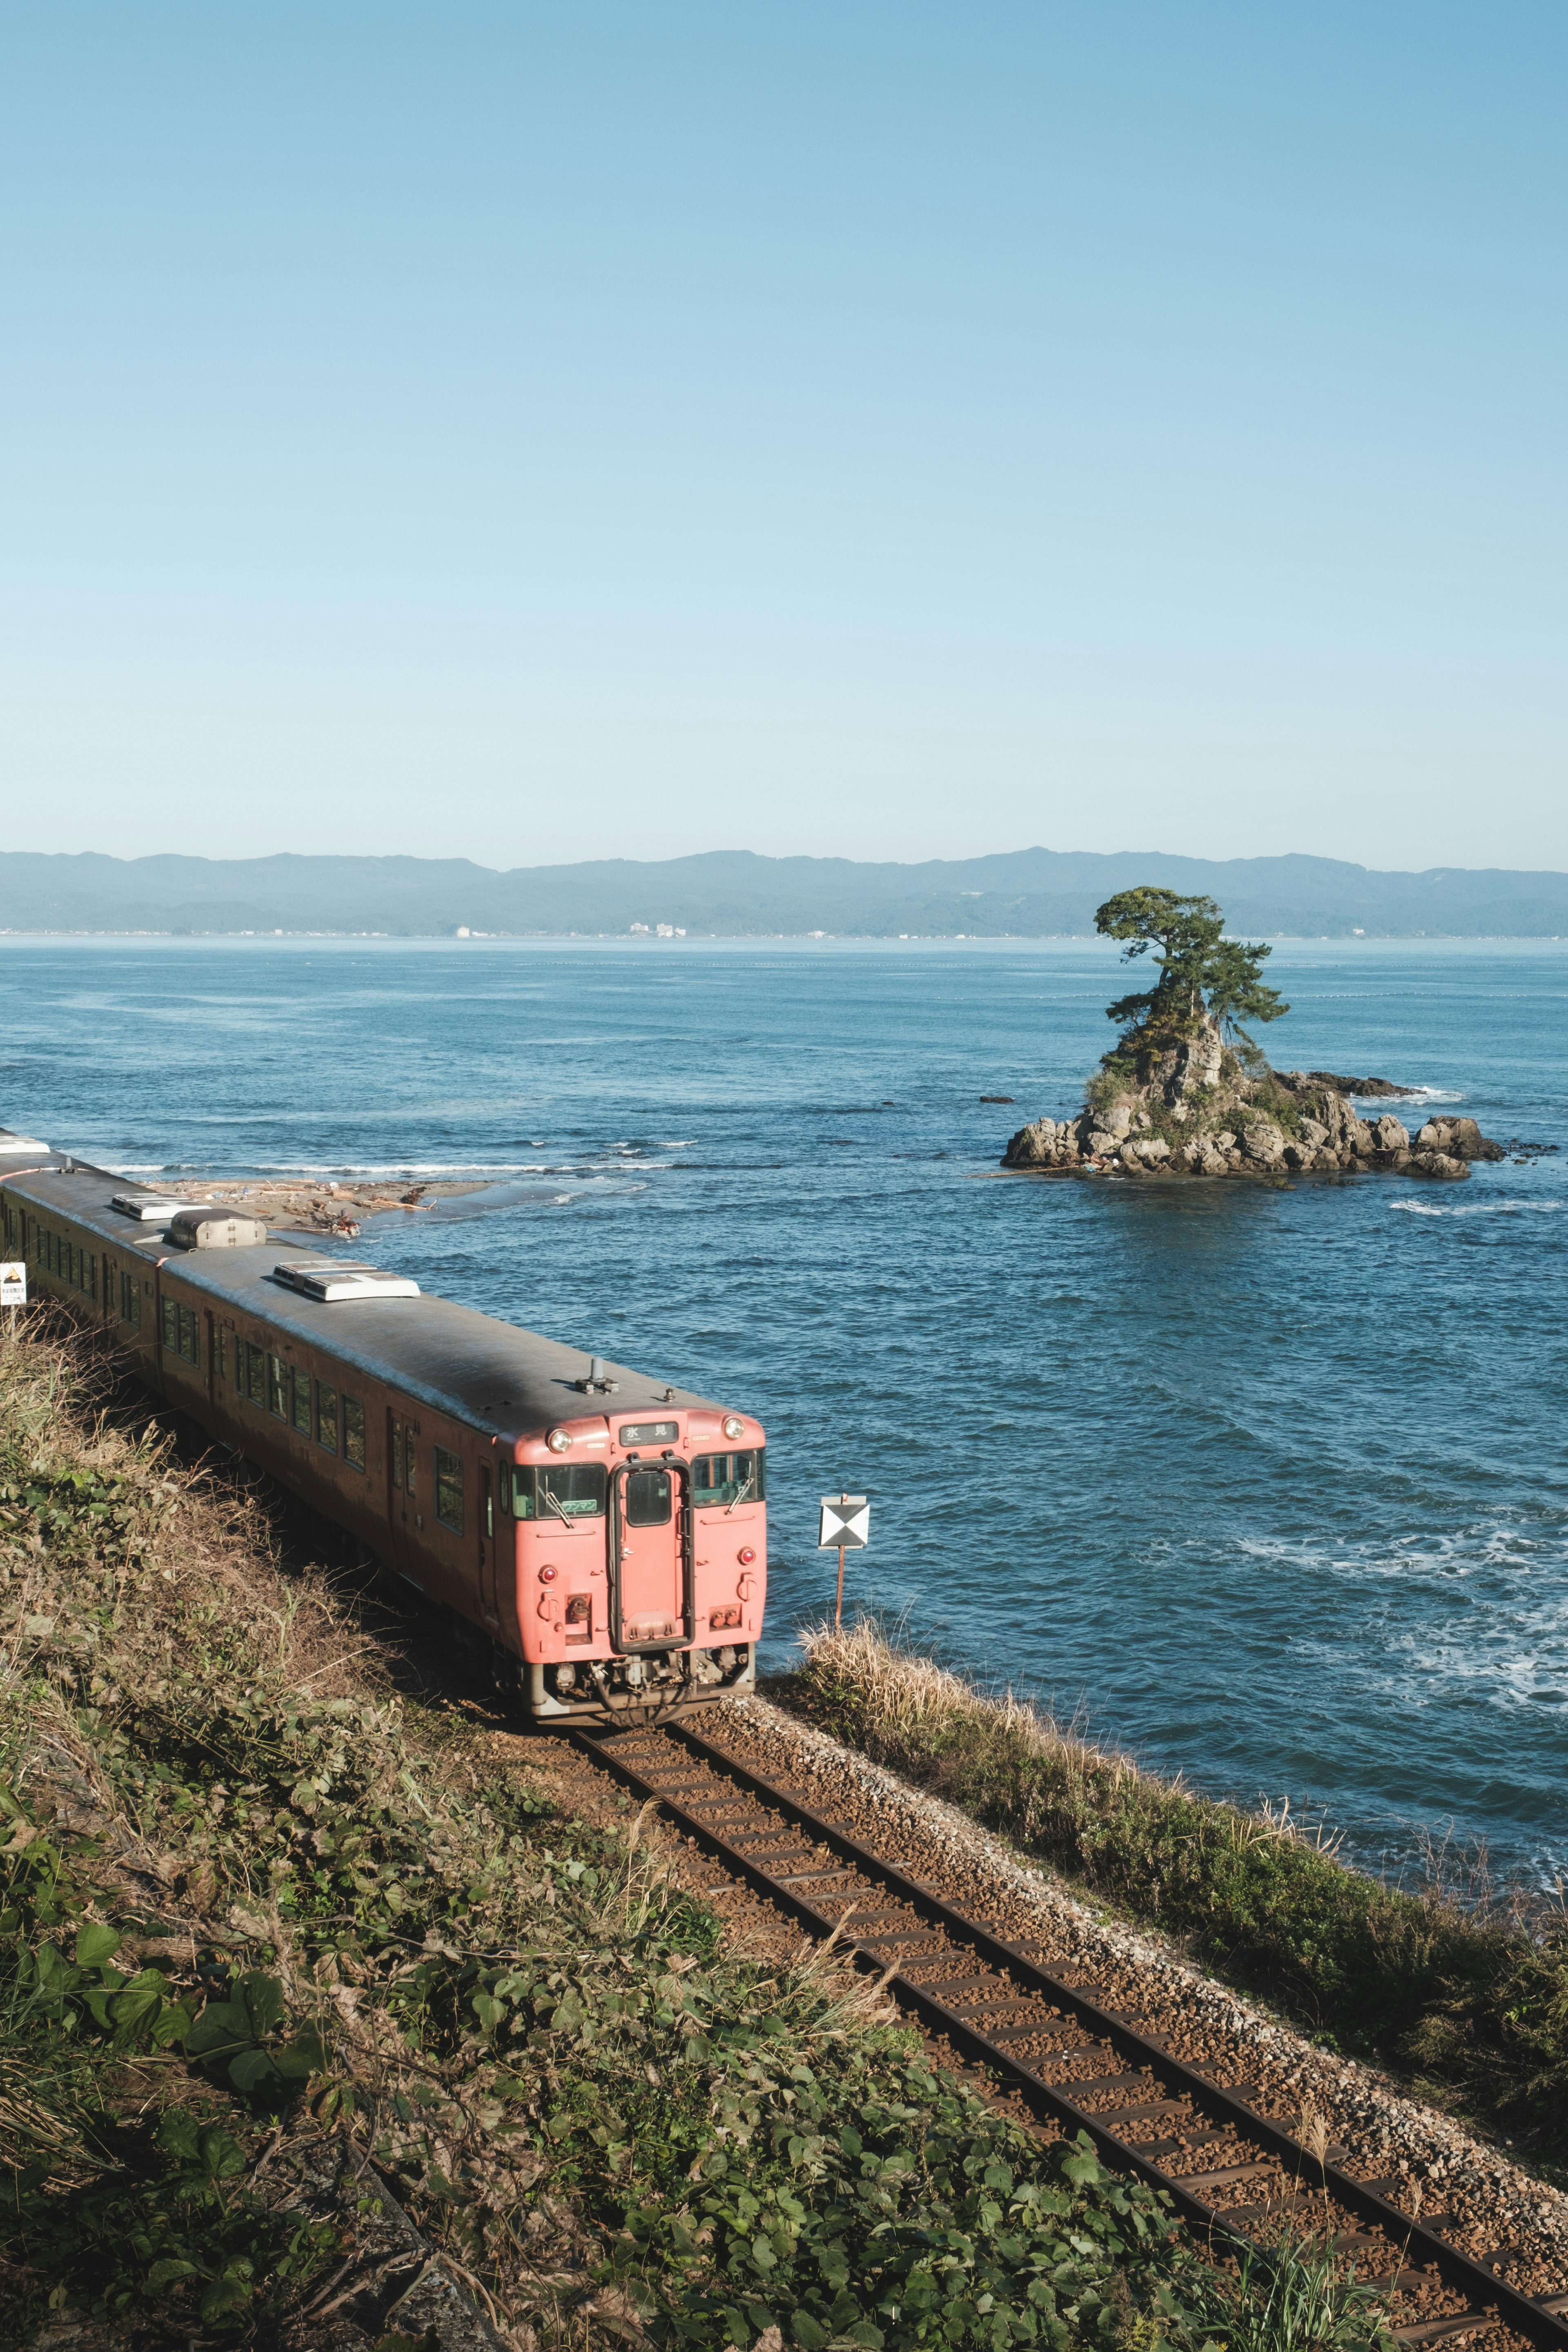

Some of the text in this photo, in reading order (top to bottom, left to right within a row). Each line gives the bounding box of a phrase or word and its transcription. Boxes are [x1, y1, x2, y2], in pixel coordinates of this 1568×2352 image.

[626, 1424, 666, 1438] 氷見
[563, 1502, 595, 1510] ワンマン
